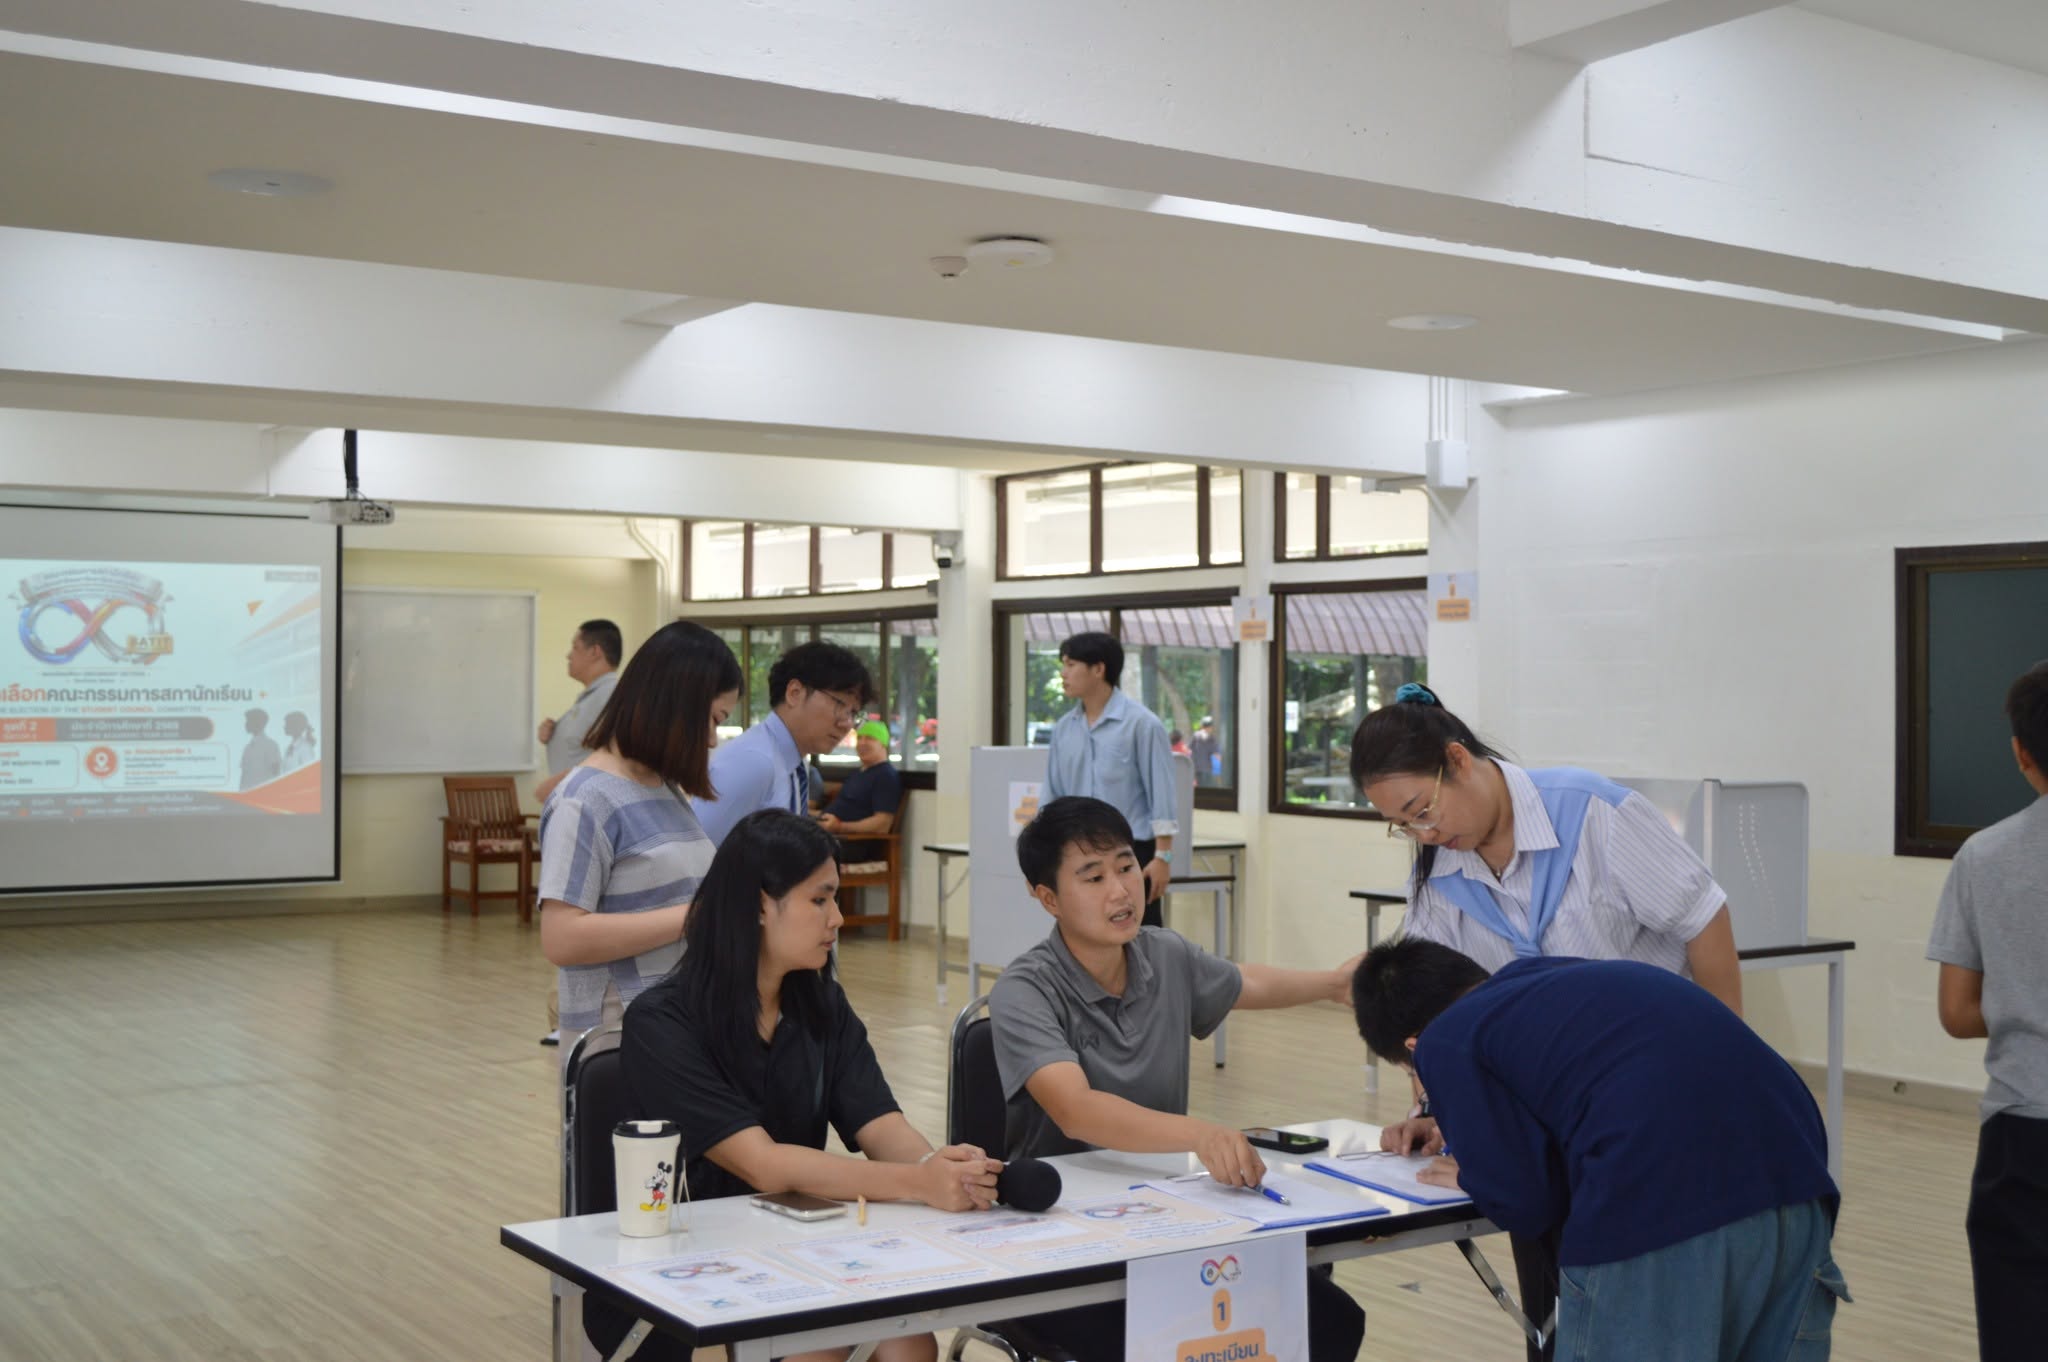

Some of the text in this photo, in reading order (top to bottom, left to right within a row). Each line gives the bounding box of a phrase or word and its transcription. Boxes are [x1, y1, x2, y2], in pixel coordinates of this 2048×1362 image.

[0, 683, 253, 702] เลือกคณะกรรมการสภานักเรียน
[1217, 1302, 1225, 1321] 1
